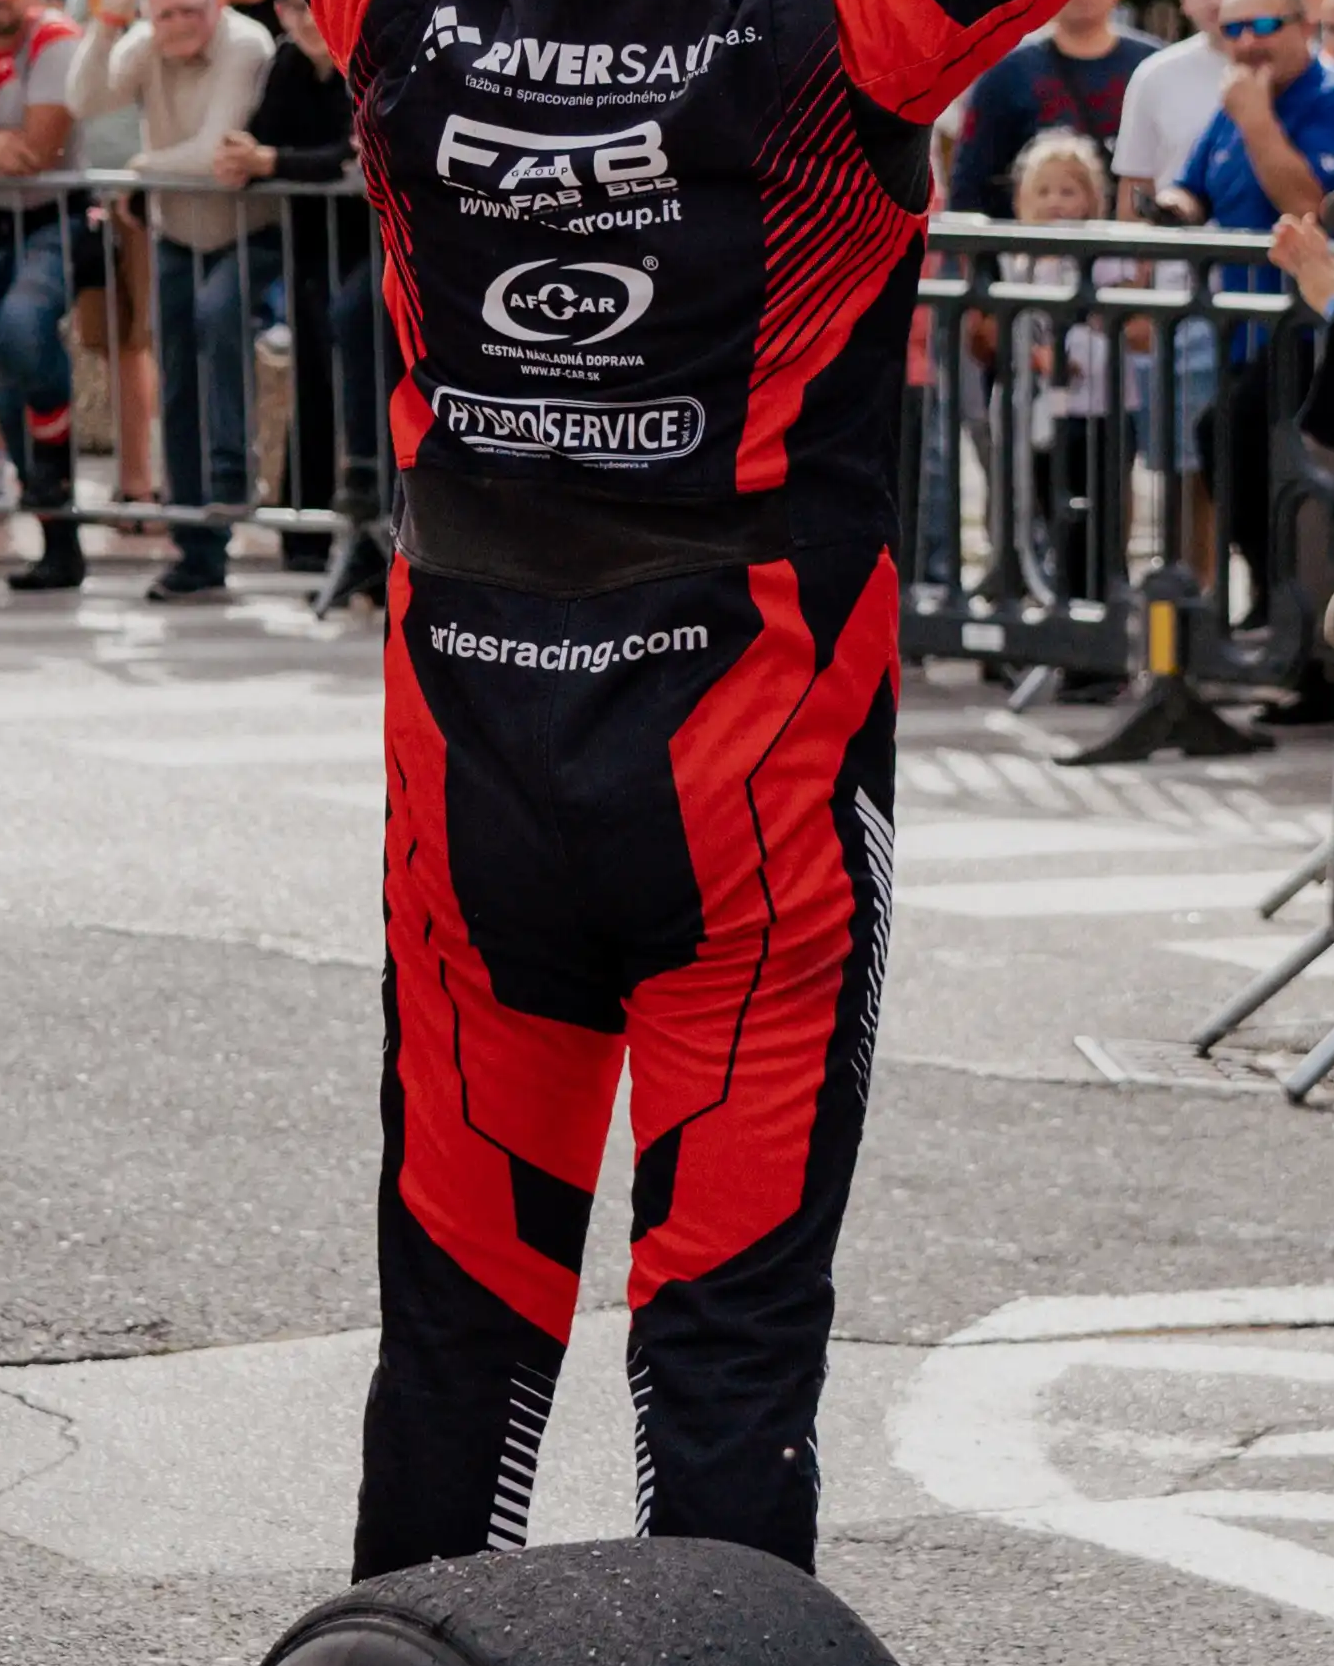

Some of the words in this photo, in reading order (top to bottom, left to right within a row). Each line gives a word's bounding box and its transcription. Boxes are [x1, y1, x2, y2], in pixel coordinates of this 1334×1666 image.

[725, 26, 763, 46] a.s.
[465, 72, 501, 95] ťažba
[503, 85, 513, 97] a
[516, 86, 595, 107] spracovanie
[596, 89, 666, 109] prírodného
[436, 113, 669, 190] FAB
[510, 166, 570, 178] GROUP
[481, 342, 525, 360] CESTNÁ
[525, 347, 584, 367] NÁKLADNÁ
[586, 353, 645, 367] DOPRAVA
[520, 364, 601, 382] WWW.AF-CAR.SK
[429, 621, 709, 674] ariesracing.com
